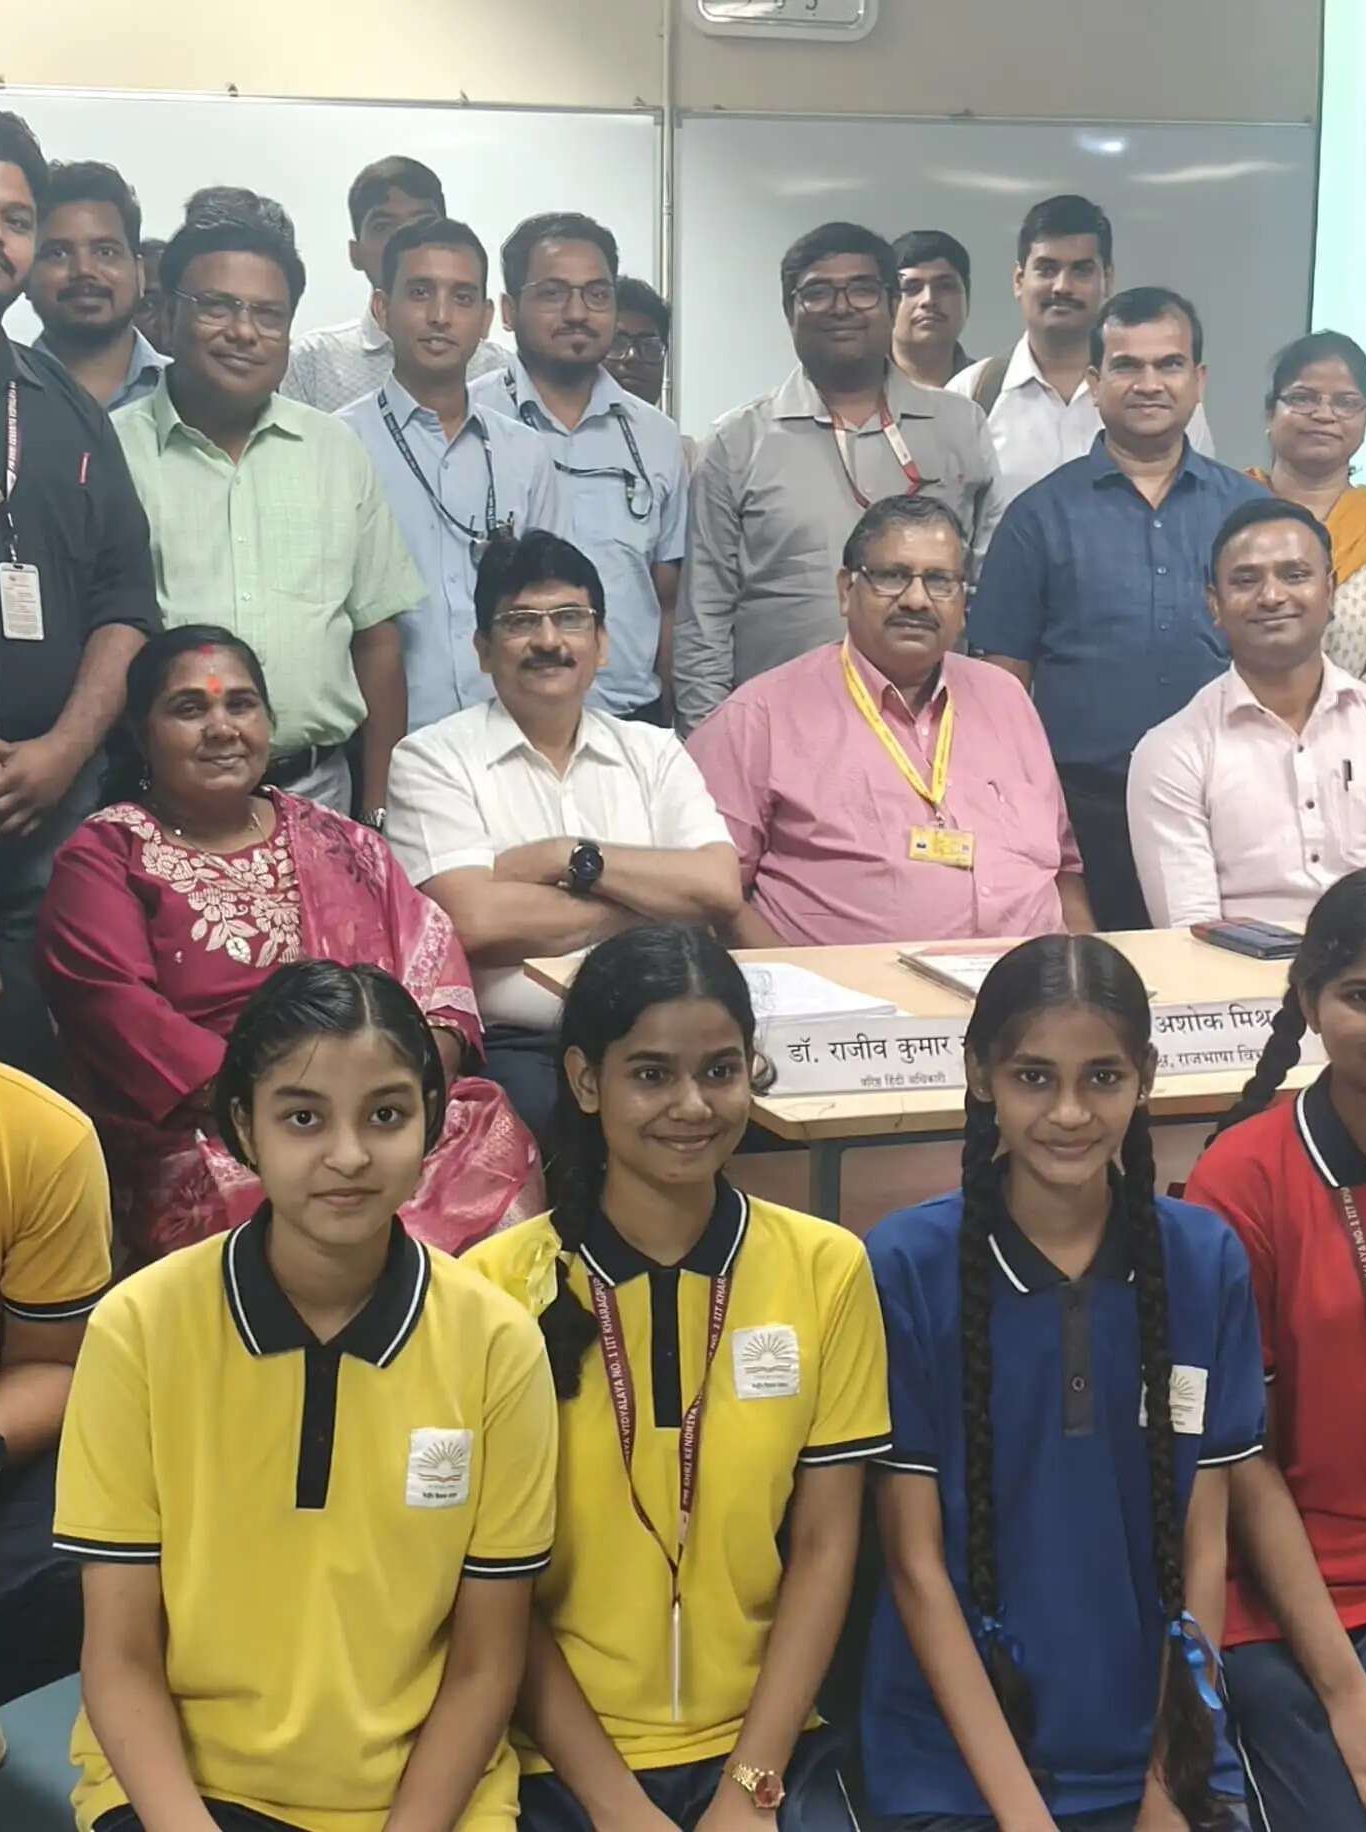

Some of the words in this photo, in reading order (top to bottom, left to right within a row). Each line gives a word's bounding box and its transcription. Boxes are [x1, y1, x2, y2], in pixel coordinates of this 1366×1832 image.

[1155, 1006, 1225, 1034] अशोक
[787, 1036, 819, 1063] डॉ.
[827, 1032, 887, 1062] राजीव
[896, 1035, 953, 1064] कुमार
[1176, 1050, 1234, 1067] राजभाषा
[604, 1335, 617, 1350] IIT
[608, 1360, 622, 1378] NO.
[613, 1378, 631, 1435] VIDYALAYA
